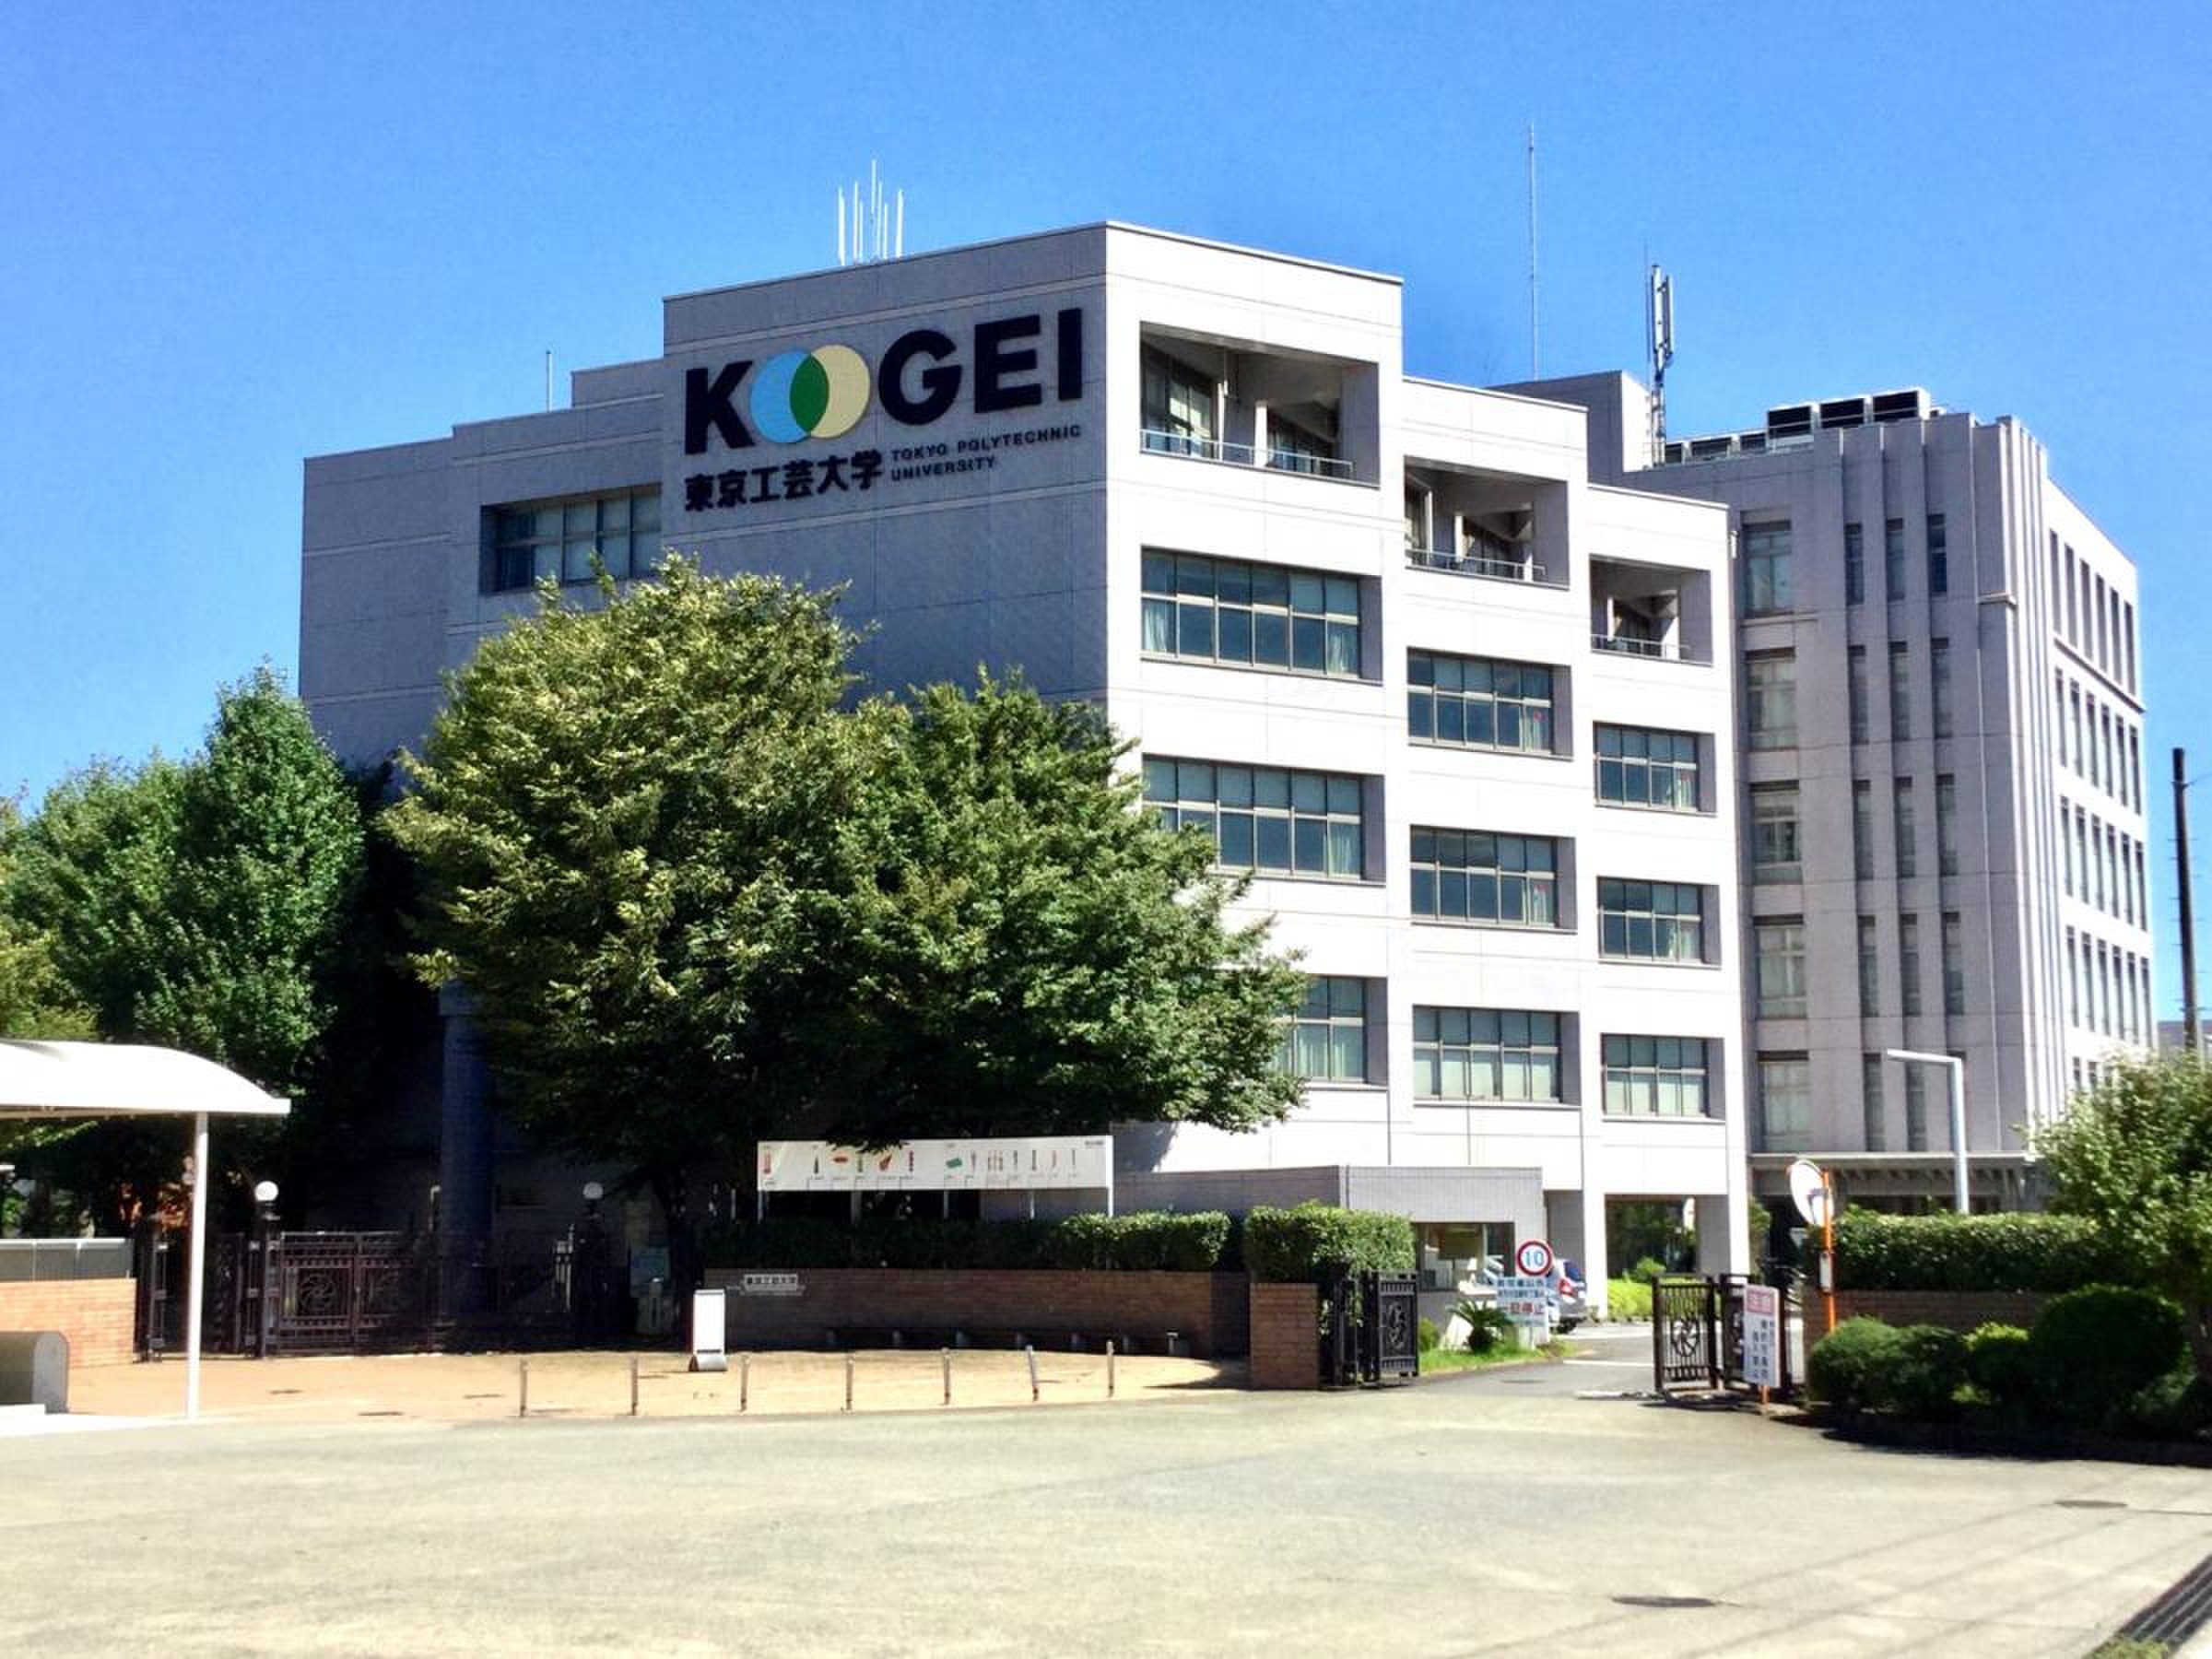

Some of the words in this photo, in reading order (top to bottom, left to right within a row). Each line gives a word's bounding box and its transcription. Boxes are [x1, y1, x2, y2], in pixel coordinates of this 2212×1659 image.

[890, 443, 947, 461] TOKYO
[958, 424, 1082, 453] POLYTECHNIC
[684, 449, 883, 512] 東京工芸大学
[890, 457, 996, 481] UNIVERSITY
[1525, 1251, 1545, 1266] 10
